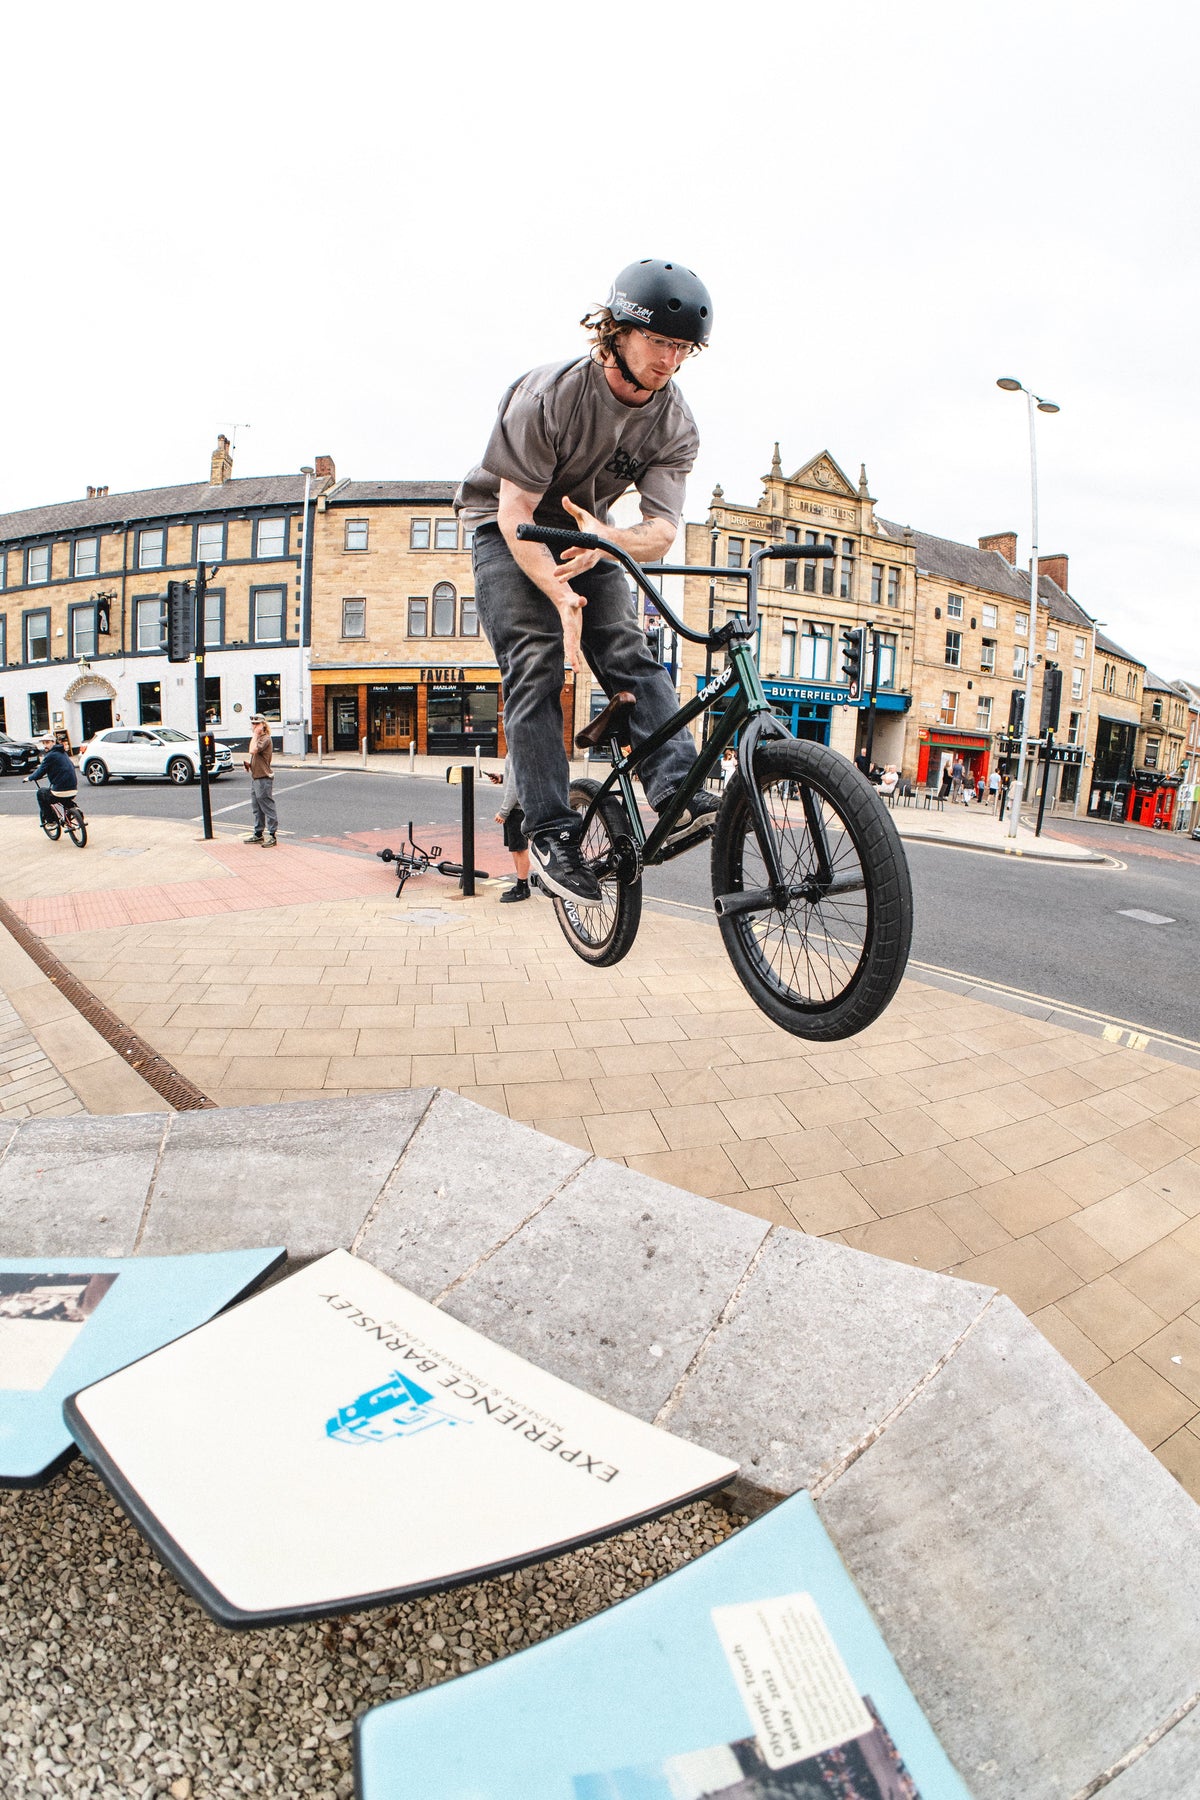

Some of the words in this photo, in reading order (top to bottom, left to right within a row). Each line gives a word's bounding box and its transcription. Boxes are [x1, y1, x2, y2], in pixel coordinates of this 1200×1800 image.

[635, 305, 654, 318] JAM
[420, 668, 465, 682] FAVELA
[771, 686, 852, 703] BUTTERFIELD'S
[1049, 750, 1078, 762] ABU
[319, 1293, 439, 1373] BARNSLEY
[383, 1319, 426, 1347] CENTRE
[427, 1349, 489, 1389] DISCOVERY
[437, 1374, 620, 1483] EXPERIENCE
[502, 1395, 565, 1433] MUSEUM
[734, 1644, 756, 1688] Torch
[762, 1669, 781, 1700] 2012
[752, 1690, 785, 1758] Olympic
